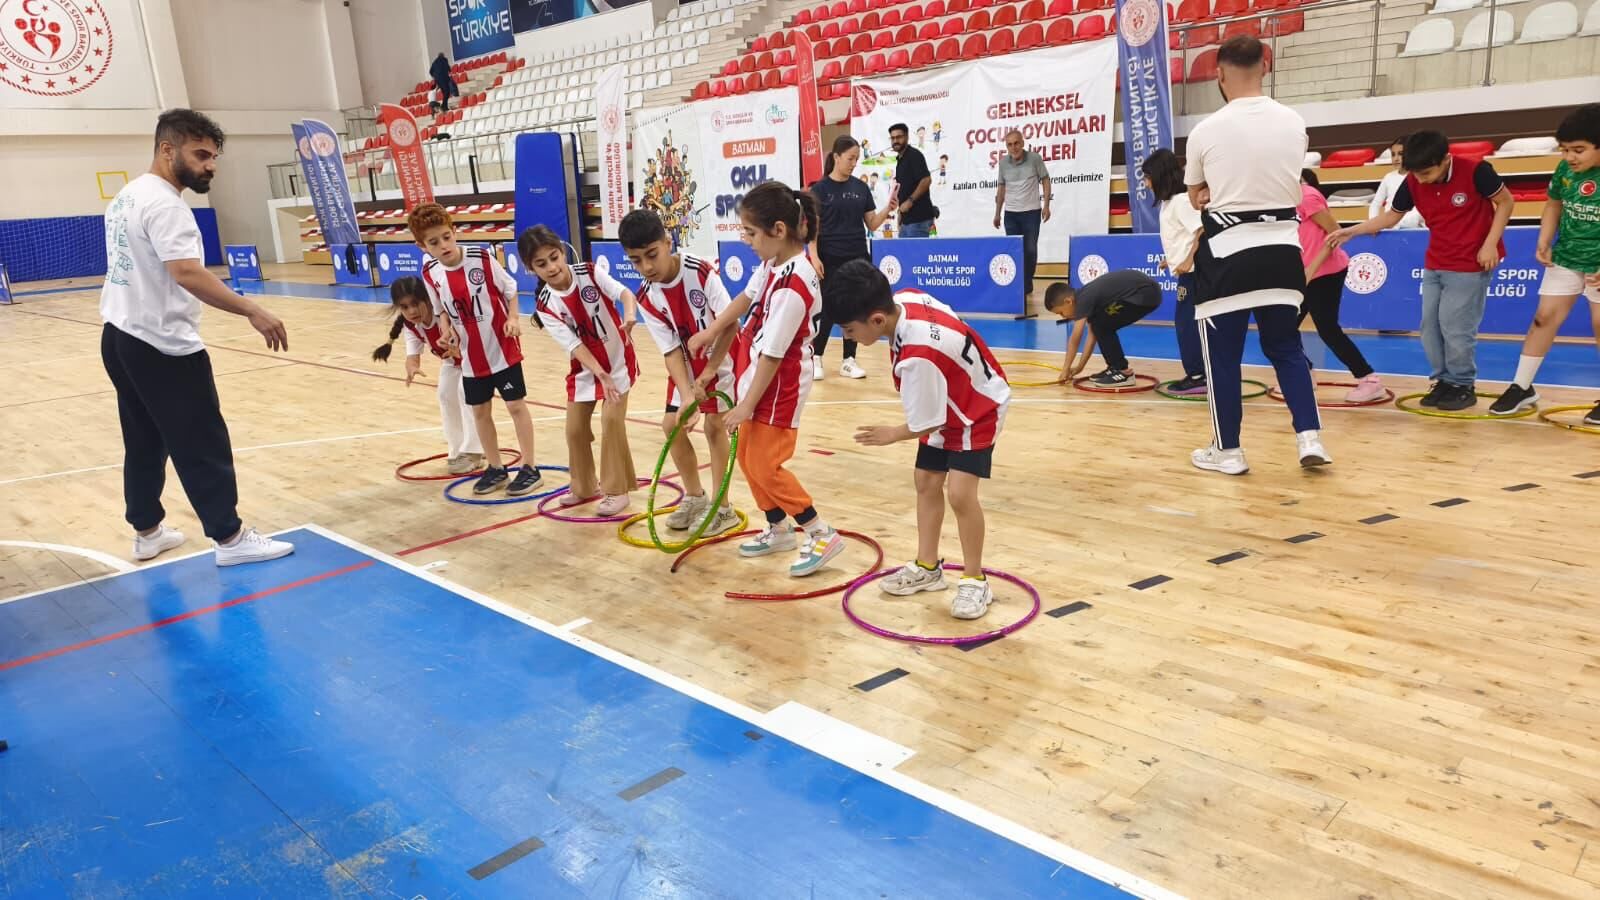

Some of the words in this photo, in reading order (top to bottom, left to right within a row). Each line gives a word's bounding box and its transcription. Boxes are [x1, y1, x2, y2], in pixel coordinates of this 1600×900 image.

[452, 10, 510, 44] TÜRKİYE
[986, 92, 1084, 120] GELENEKSEL
[1022, 114, 1106, 140] OYUNLARI
[732, 141, 766, 155] BATMAN
[605, 154, 614, 188] GENÇLİK
[608, 191, 616, 224] BATMAN
[928, 254, 959, 263] BATMAN
[912, 265, 943, 276] GENÇLİK
[944, 266, 954, 275] VE
[955, 266, 976, 275] SPOR
[1498, 268, 1538, 281] SPOR
[917, 276, 924, 286] İL
[925, 276, 971, 286] MÜDÜRLÜĞÜ
